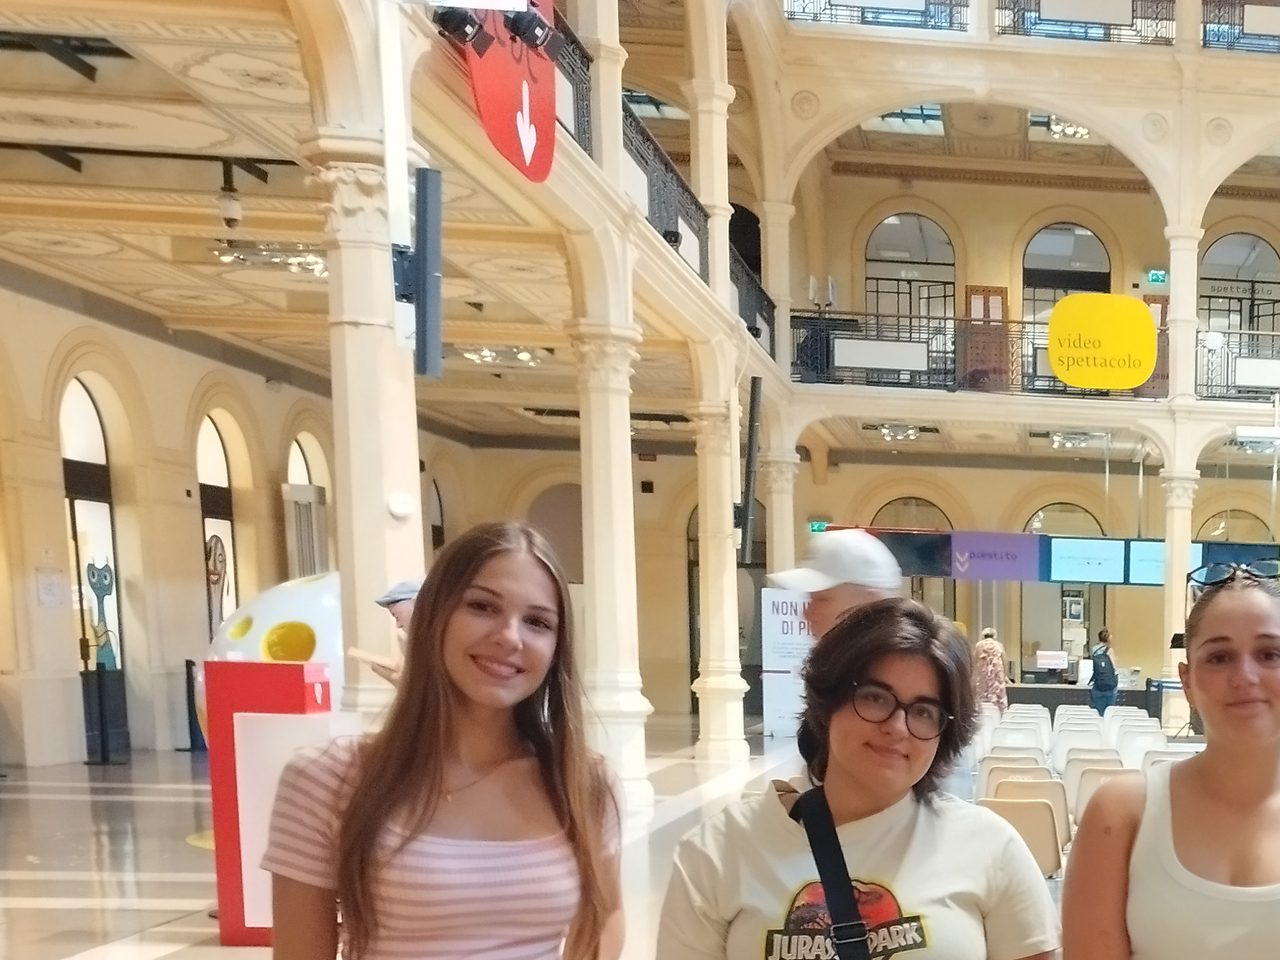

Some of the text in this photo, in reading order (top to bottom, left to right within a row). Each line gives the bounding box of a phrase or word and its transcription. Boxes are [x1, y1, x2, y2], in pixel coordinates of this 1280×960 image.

[1057, 332, 1102, 349] video
[1057, 354, 1142, 371] spettacolo
[771, 600, 798, 616] NON
[781, 620, 794, 636] DI
[867, 922, 923, 954] PARK
